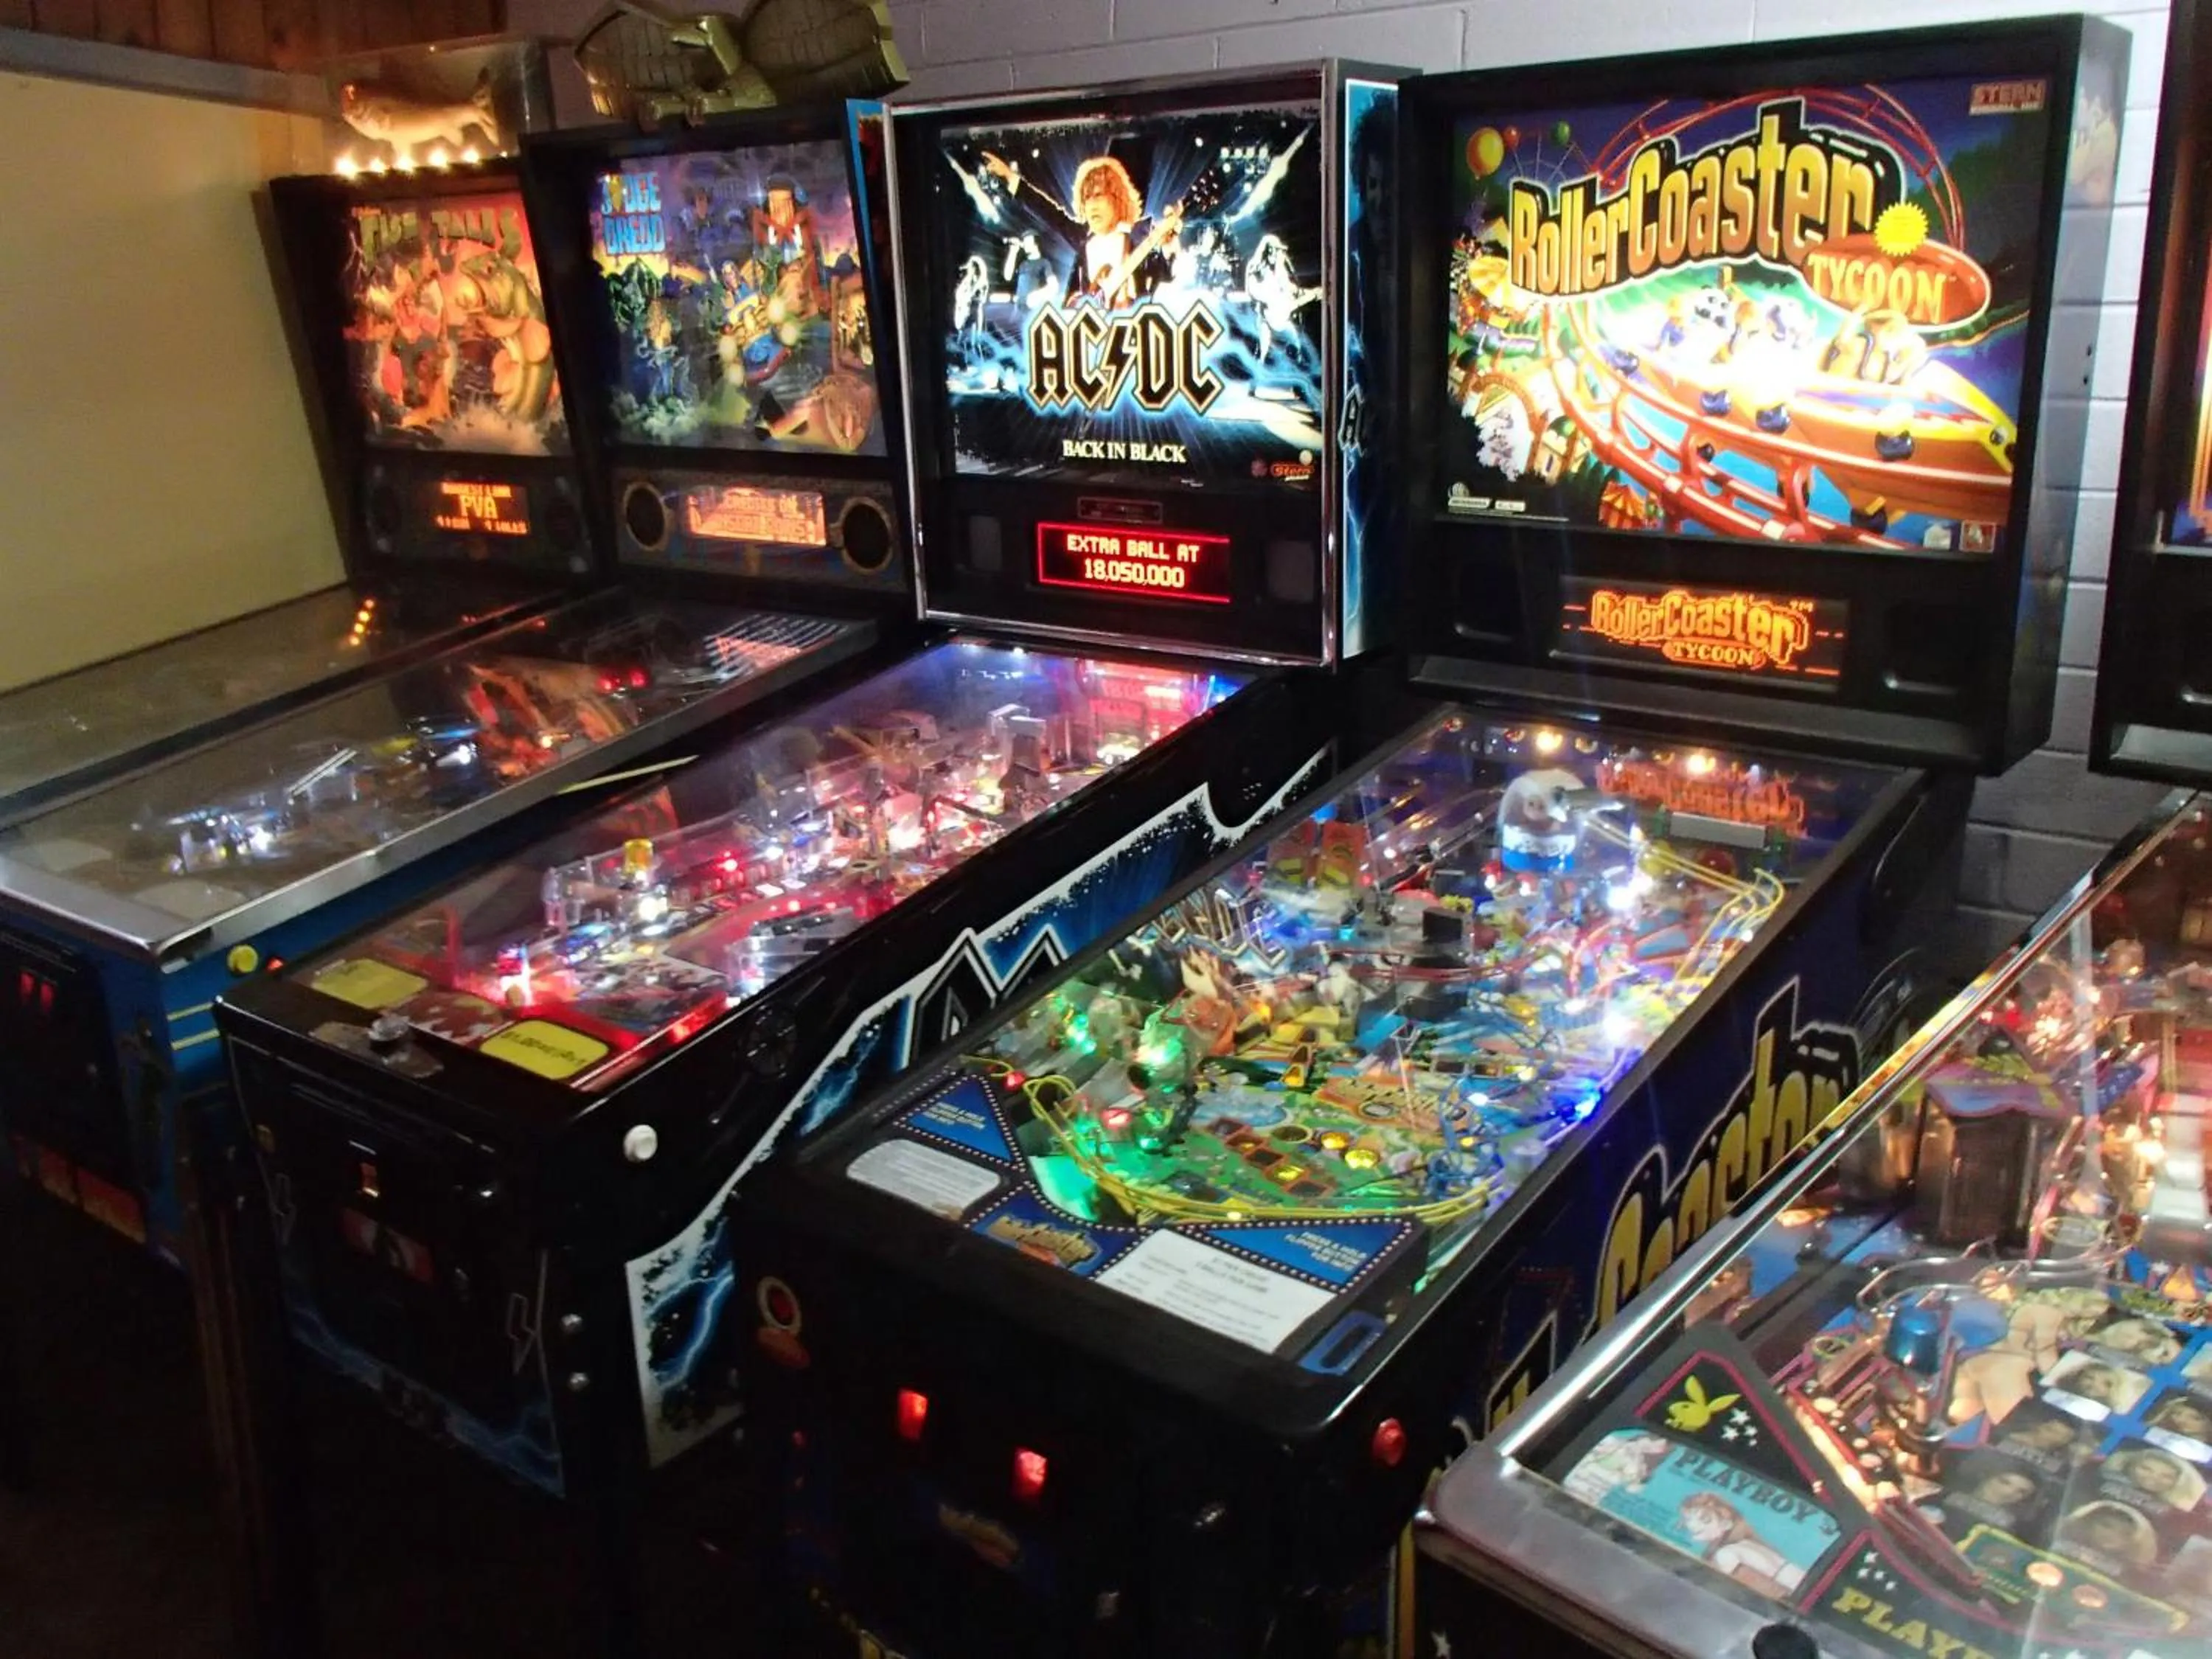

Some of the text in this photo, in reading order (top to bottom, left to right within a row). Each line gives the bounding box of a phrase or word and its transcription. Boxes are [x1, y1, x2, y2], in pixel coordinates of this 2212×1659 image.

[1509, 114, 1877, 296] RollerCoaster
[1808, 254, 1947, 324] TYCOON
[1062, 440, 1186, 463] BACK IN BLACK
[1067, 534, 1200, 563] EXTRA BALL AT
[1084, 558, 1185, 588] 18,050,000
[1593, 590, 1809, 664] RollerCoaster
[1674, 641, 1755, 666] TYCOON
[1673, 1448, 1819, 1523] PLAYBOY
